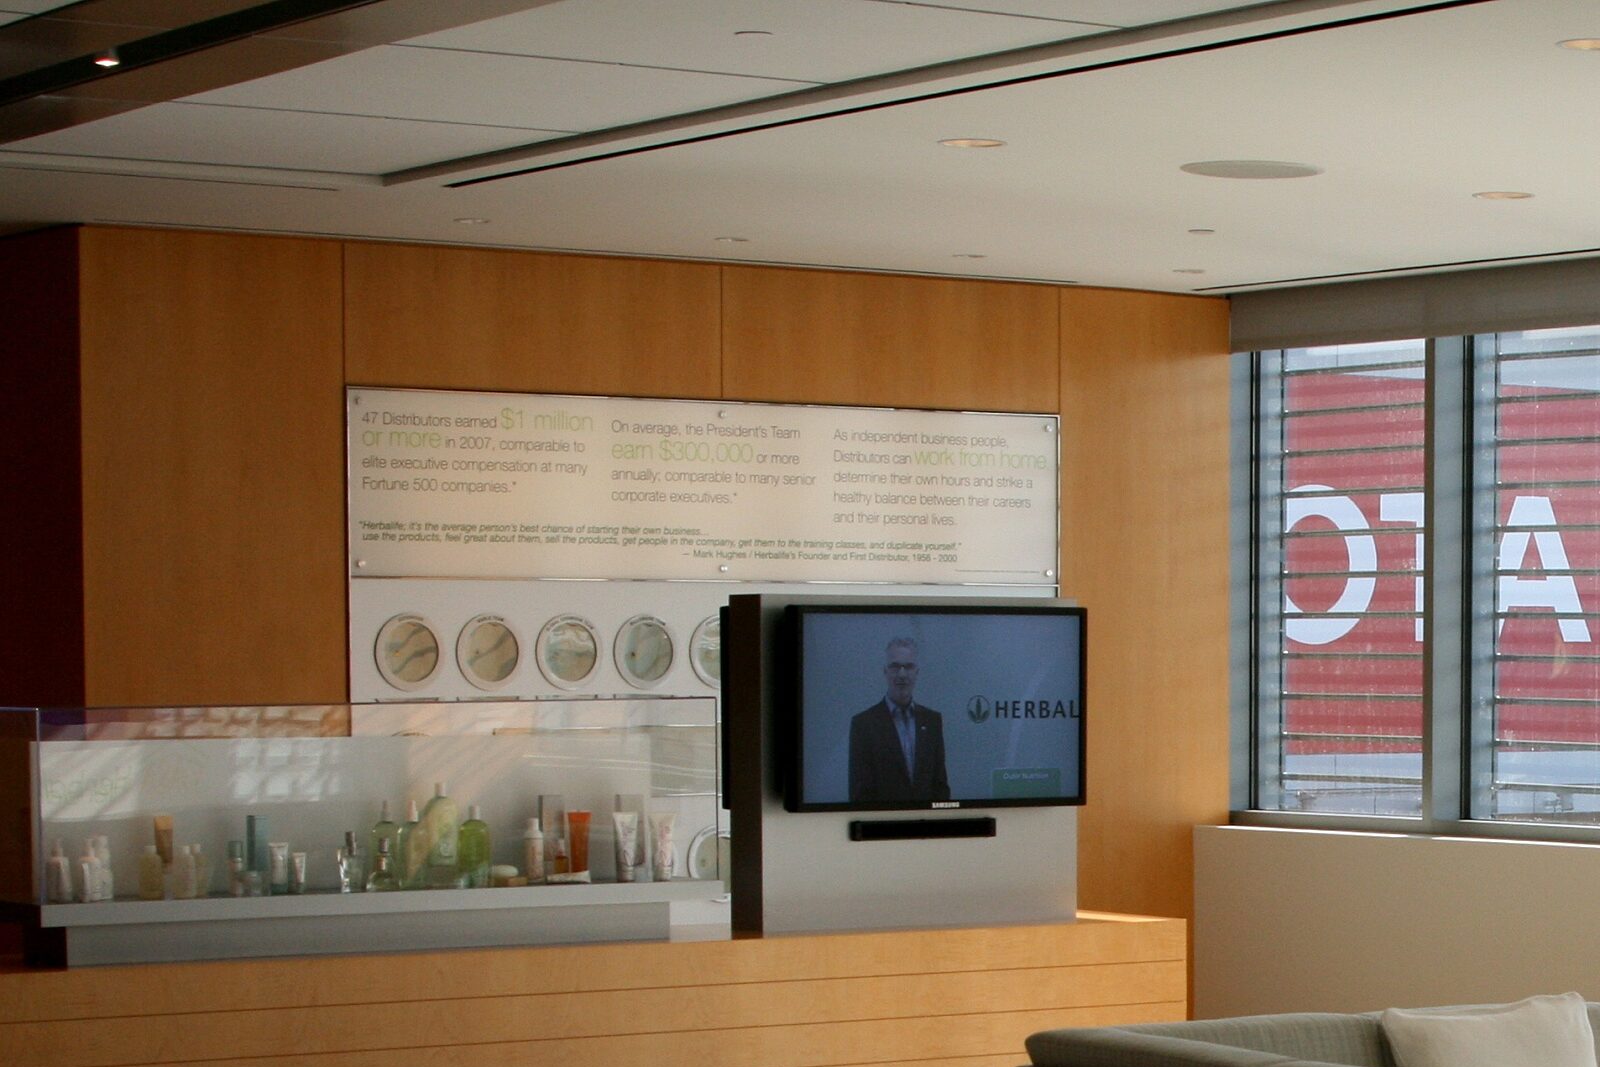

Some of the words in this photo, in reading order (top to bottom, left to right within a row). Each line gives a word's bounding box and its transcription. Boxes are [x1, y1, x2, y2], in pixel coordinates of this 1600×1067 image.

[362, 412, 378, 424] 47
[383, 411, 451, 427] Distributors
[455, 416, 497, 429] earned
[501, 408, 523, 430] $1
[534, 410, 594, 431] million
[611, 420, 629, 433] On
[632, 424, 682, 438] average,
[686, 423, 703, 436] the
[707, 423, 768, 438] President's
[771, 425, 800, 439] Team
[834, 429, 848, 441] As
[851, 430, 918, 444] independent
[921, 433, 968, 446] business
[362, 430, 383, 447] or
[390, 432, 441, 448] more
[445, 436, 456, 448] in
[500, 440, 570, 454] comparable
[574, 441, 586, 453] to
[611, 443, 653, 459] earn
[660, 439, 753, 463] $300,000
[756, 454, 768, 464] or
[771, 454, 800, 465] more
[833, 450, 890, 464] Distributors
[892, 454, 912, 464] can
[914, 449, 954, 466] work
[960, 449, 995, 467] from
[362, 456, 387, 468] elite
[390, 458, 448, 470] executive
[452, 460, 537, 473] compensation
[541, 461, 552, 473] at
[556, 463, 588, 476] many
[362, 476, 409, 491] Fortune
[413, 478, 438, 492] 500
[665, 471, 732, 485] comparable
[735, 472, 746, 484] to
[750, 474, 780, 487] many
[783, 474, 816, 486] senior
[834, 472, 887, 484] determine
[890, 473, 912, 485] their
[915, 476, 938, 486] own
[941, 474, 971, 487] hours
[973, 476, 993, 488] and
[996, 477, 1023, 488] strike
[611, 491, 666, 503] corporate
[833, 491, 872, 506] healthy
[875, 492, 917, 505] balance
[920, 494, 965, 506] between
[968, 495, 990, 507] their
[993, 498, 1032, 509] careers
[834, 512, 855, 523] and
[858, 512, 880, 524] their
[883, 513, 928, 526] personal
[425, 521, 439, 531] the
[441, 523, 477, 534] average
[479, 523, 518, 534] person's
[519, 524, 539, 533] best
[541, 524, 573, 534] chance
[576, 524, 587, 533] of
[587, 525, 620, 536] starting
[621, 526, 642, 535] their
[643, 527, 662, 535] own
[362, 532, 380, 541] use
[382, 532, 396, 541] the
[445, 533, 462, 542] feel
[463, 534, 488, 544] great
[489, 533, 515, 543] about
[545, 535, 561, 544] sell
[562, 535, 577, 544] the
[622, 536, 636, 547] get
[638, 536, 668, 547] people
[670, 536, 678, 545] in
[680, 537, 694, 546] the
[738, 539, 753, 549] get
[754, 539, 776, 548] them
[777, 539, 786, 548] to
[788, 539, 801, 548] the
[803, 540, 834, 550] training
[869, 541, 885, 550] and
[886, 541, 923, 551] duplicate
[693, 549, 714, 559] Mark
[716, 550, 747, 561] Hughes
[754, 551, 796, 560] Herbalife's
[797, 551, 831, 561] Founder
[832, 552, 848, 561] and
[850, 552, 867, 561] First
[938, 554, 958, 563] 2000
[995, 700, 1080, 719] HERBAL
[932, 801, 960, 809] SAMSUNG
